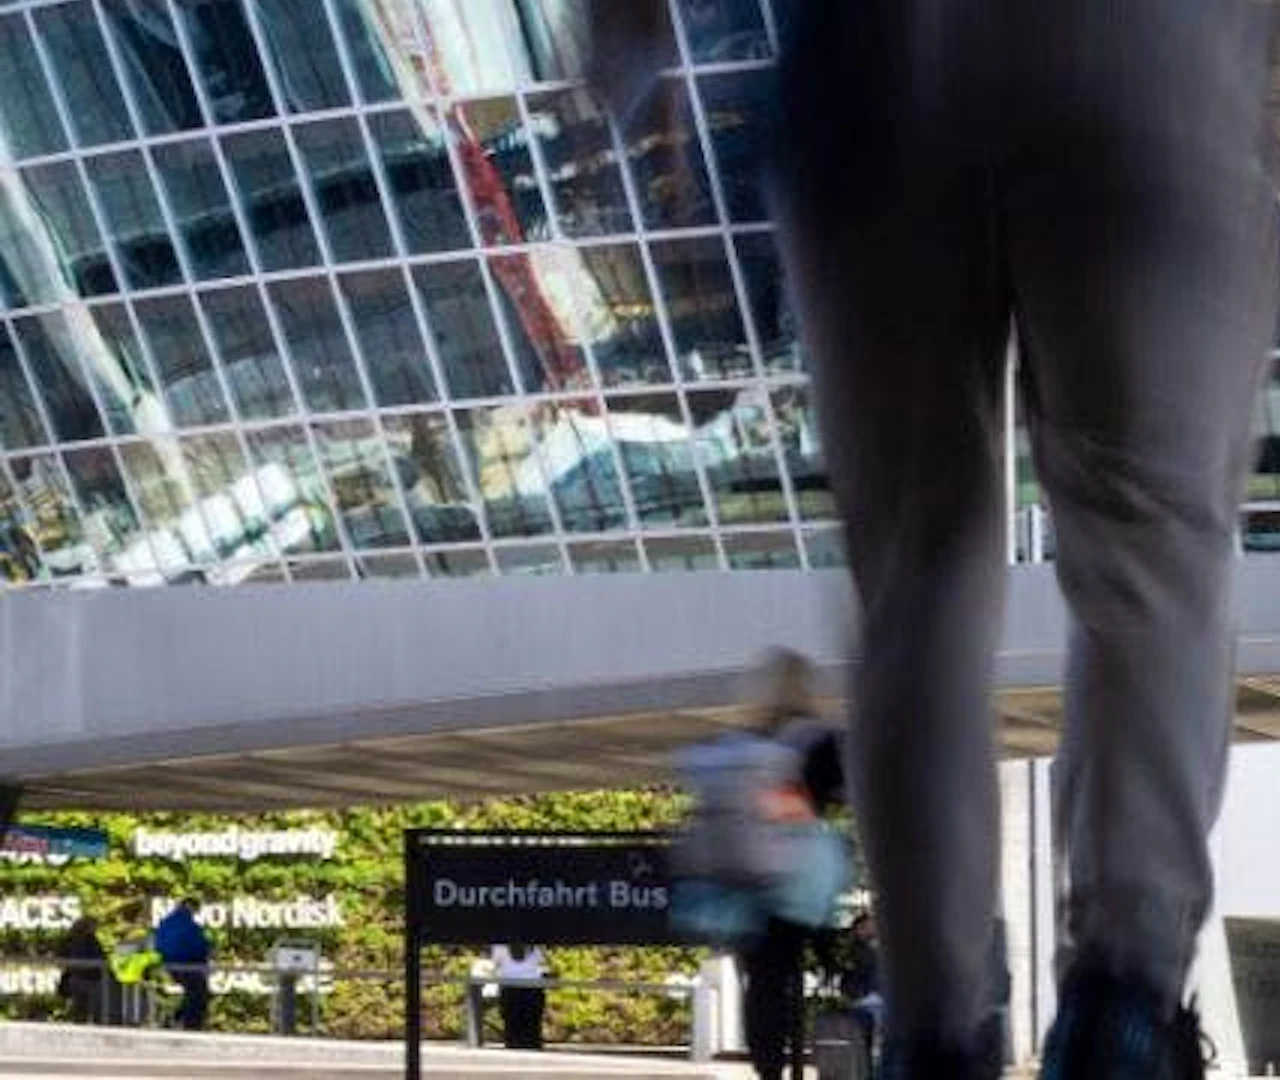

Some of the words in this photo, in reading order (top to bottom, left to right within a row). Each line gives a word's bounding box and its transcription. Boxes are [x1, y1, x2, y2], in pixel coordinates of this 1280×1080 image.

[434, 879, 597, 908] Durchfahrt
[609, 880, 669, 908] Bus
[232, 894, 345, 928] Nordisk
